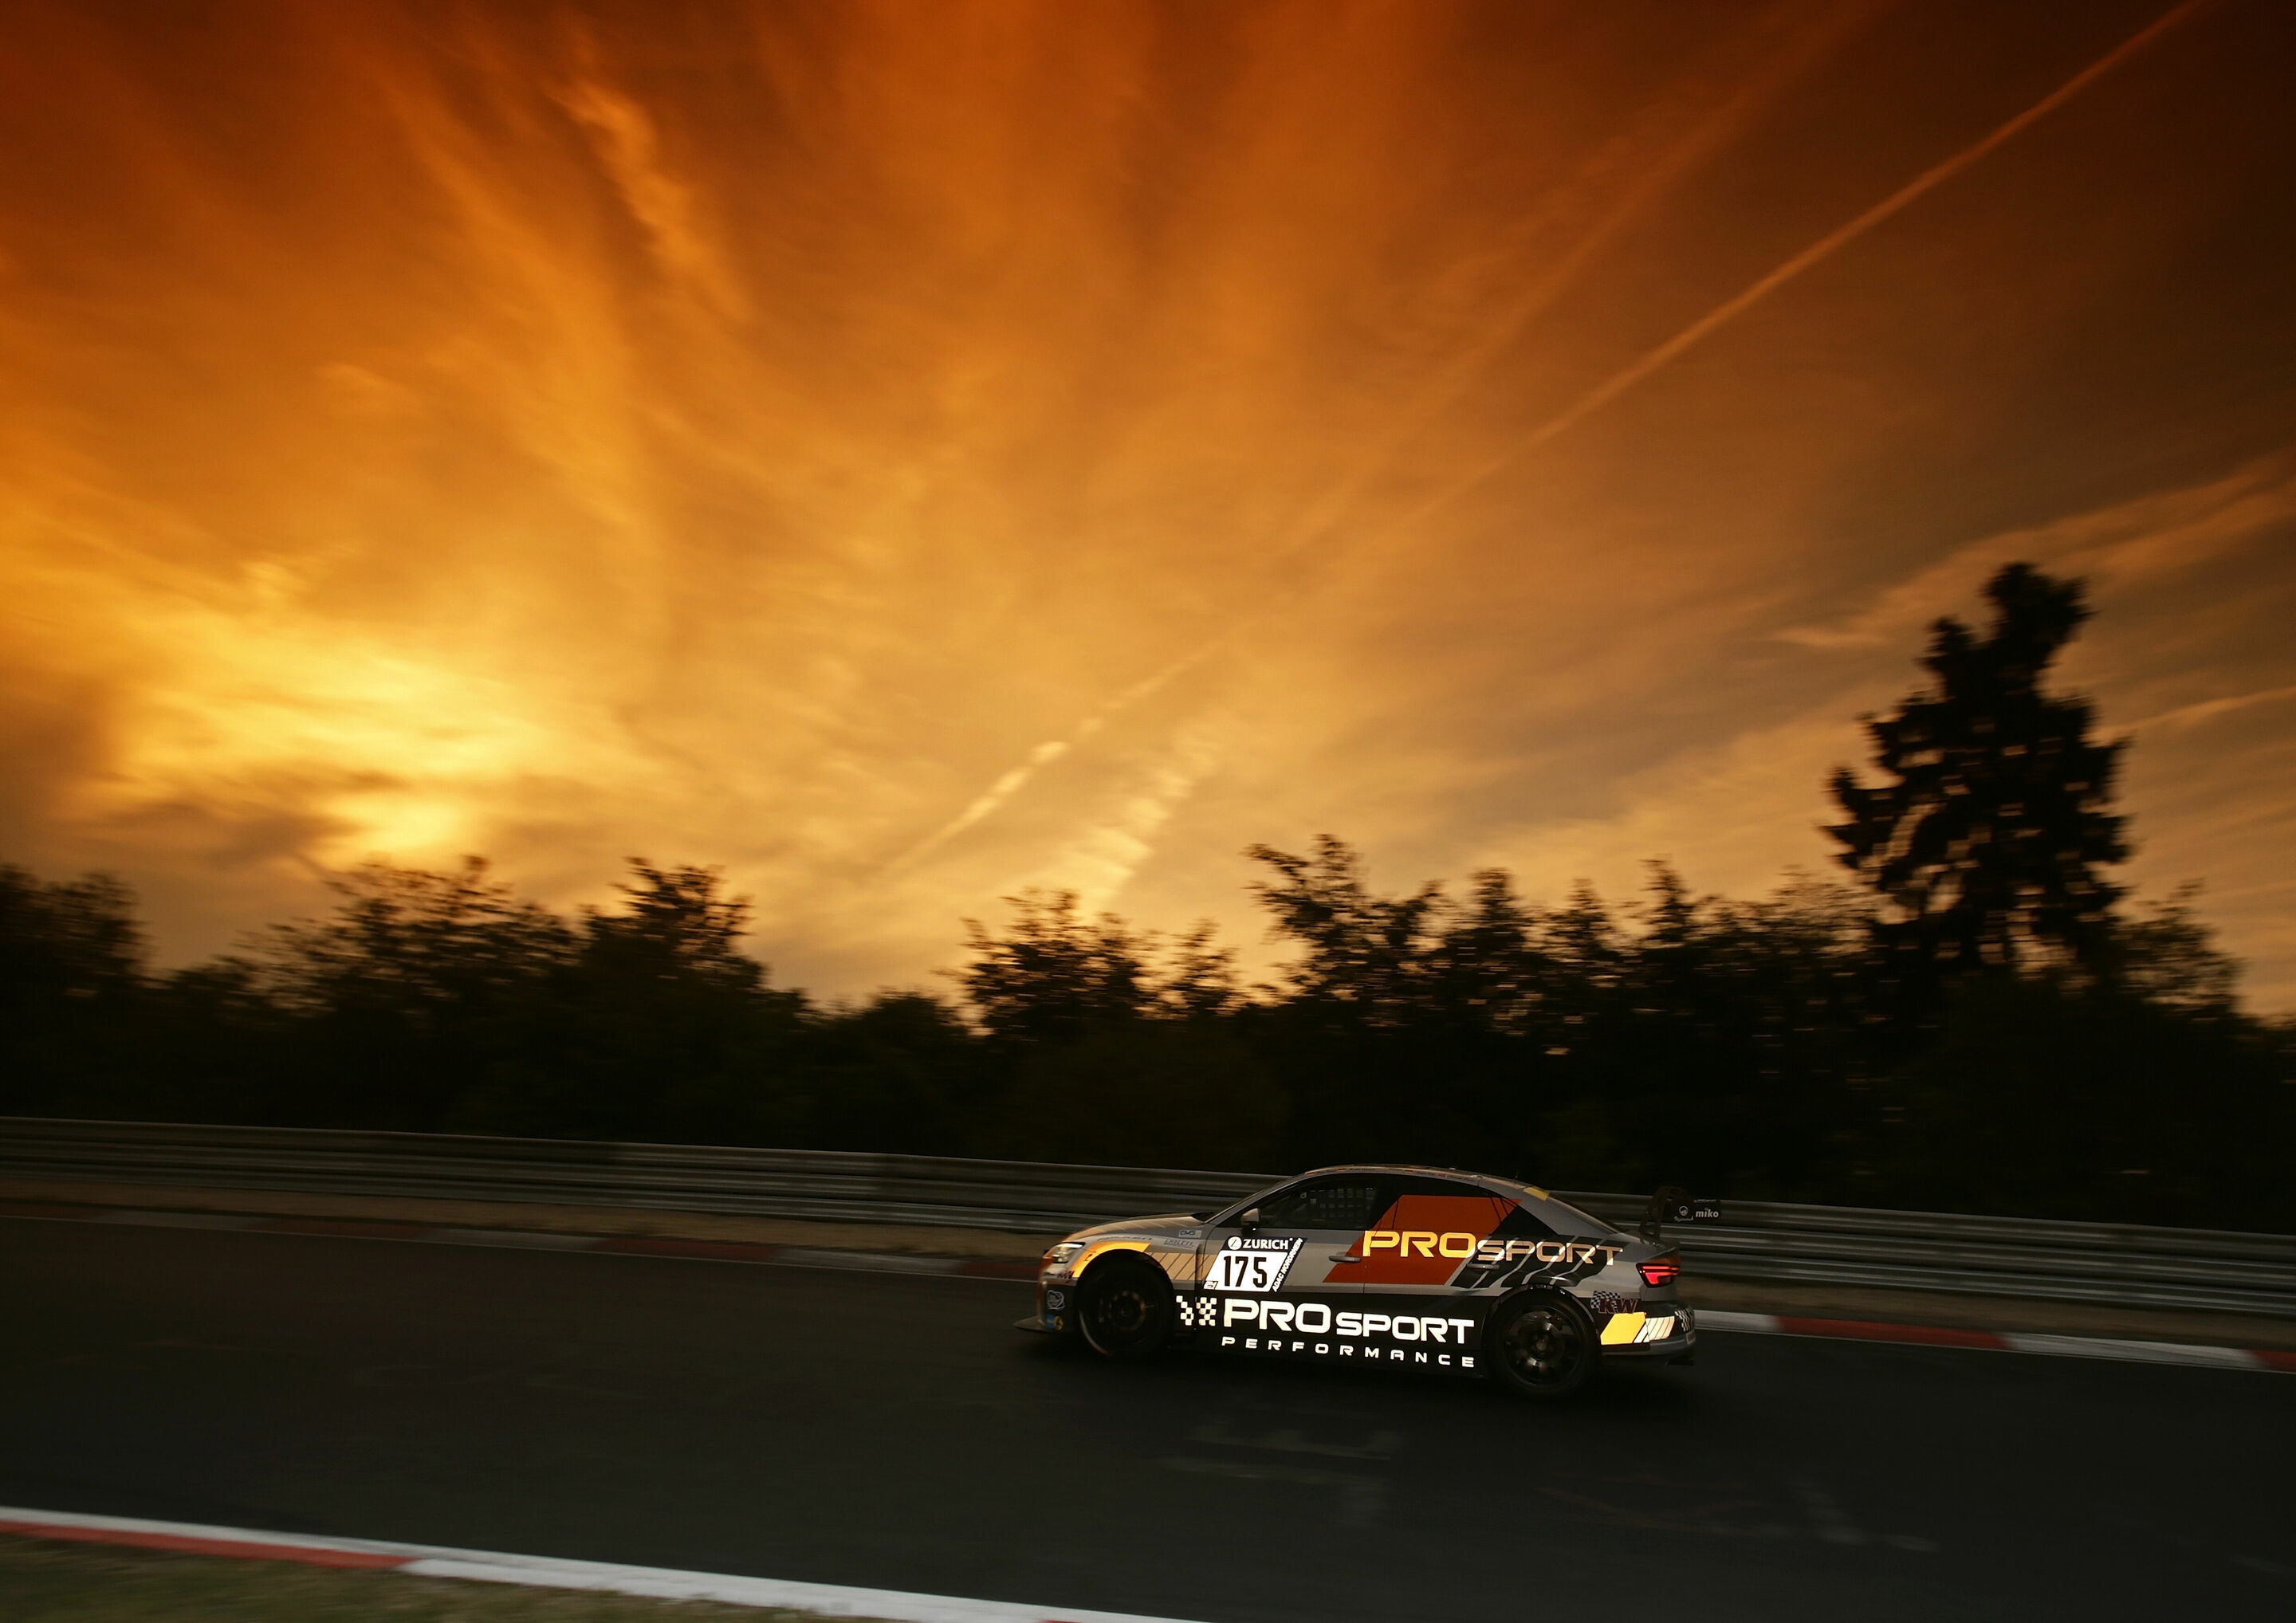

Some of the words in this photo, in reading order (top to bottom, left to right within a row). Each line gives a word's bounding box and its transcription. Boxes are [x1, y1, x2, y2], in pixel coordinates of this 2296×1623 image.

[1695, 1208, 1720, 1218] miko
[1243, 1239, 1289, 1250] ZURICH
[1224, 1256, 1268, 1288] 175
[1272, 1273, 1284, 1292] ADAC
[1221, 1336, 1474, 1368] PERFORMANCE
